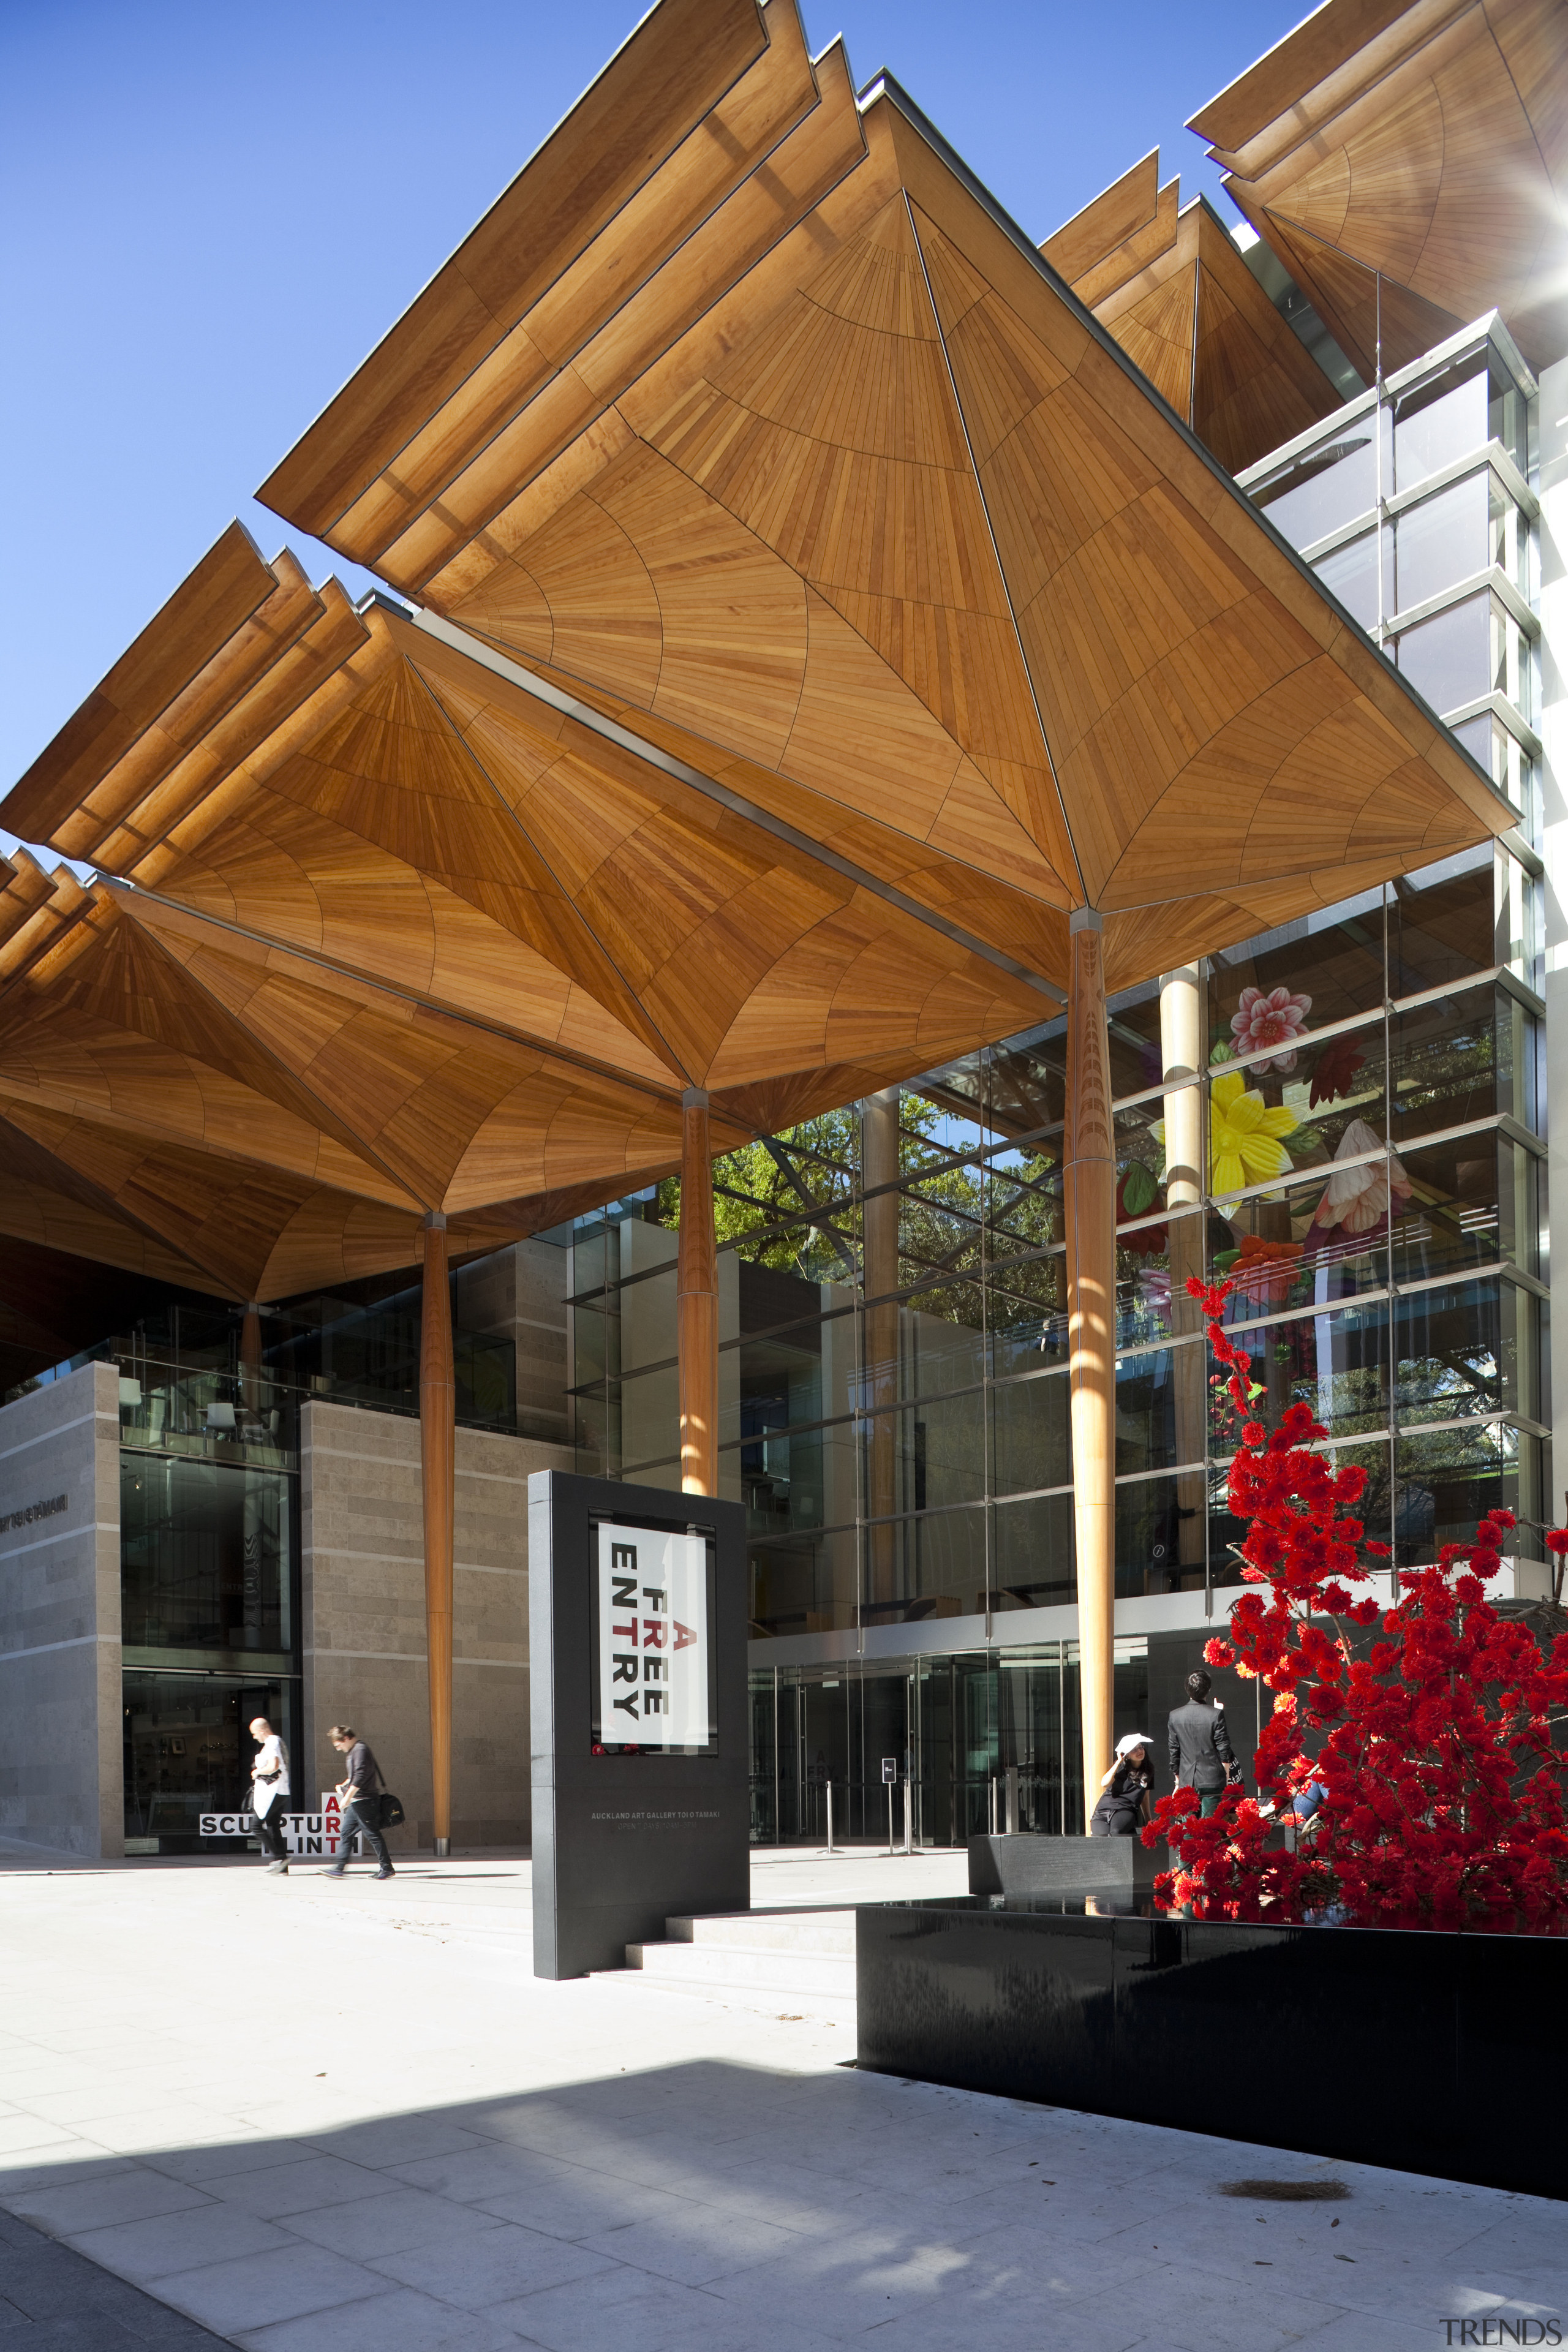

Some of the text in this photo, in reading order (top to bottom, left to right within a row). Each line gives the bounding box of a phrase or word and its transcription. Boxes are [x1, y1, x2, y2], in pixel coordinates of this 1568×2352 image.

[611, 1542, 639, 1722] ENTRY
[643, 1587, 669, 1716] FREE
[1227, 1768, 1243, 1785] Staff
